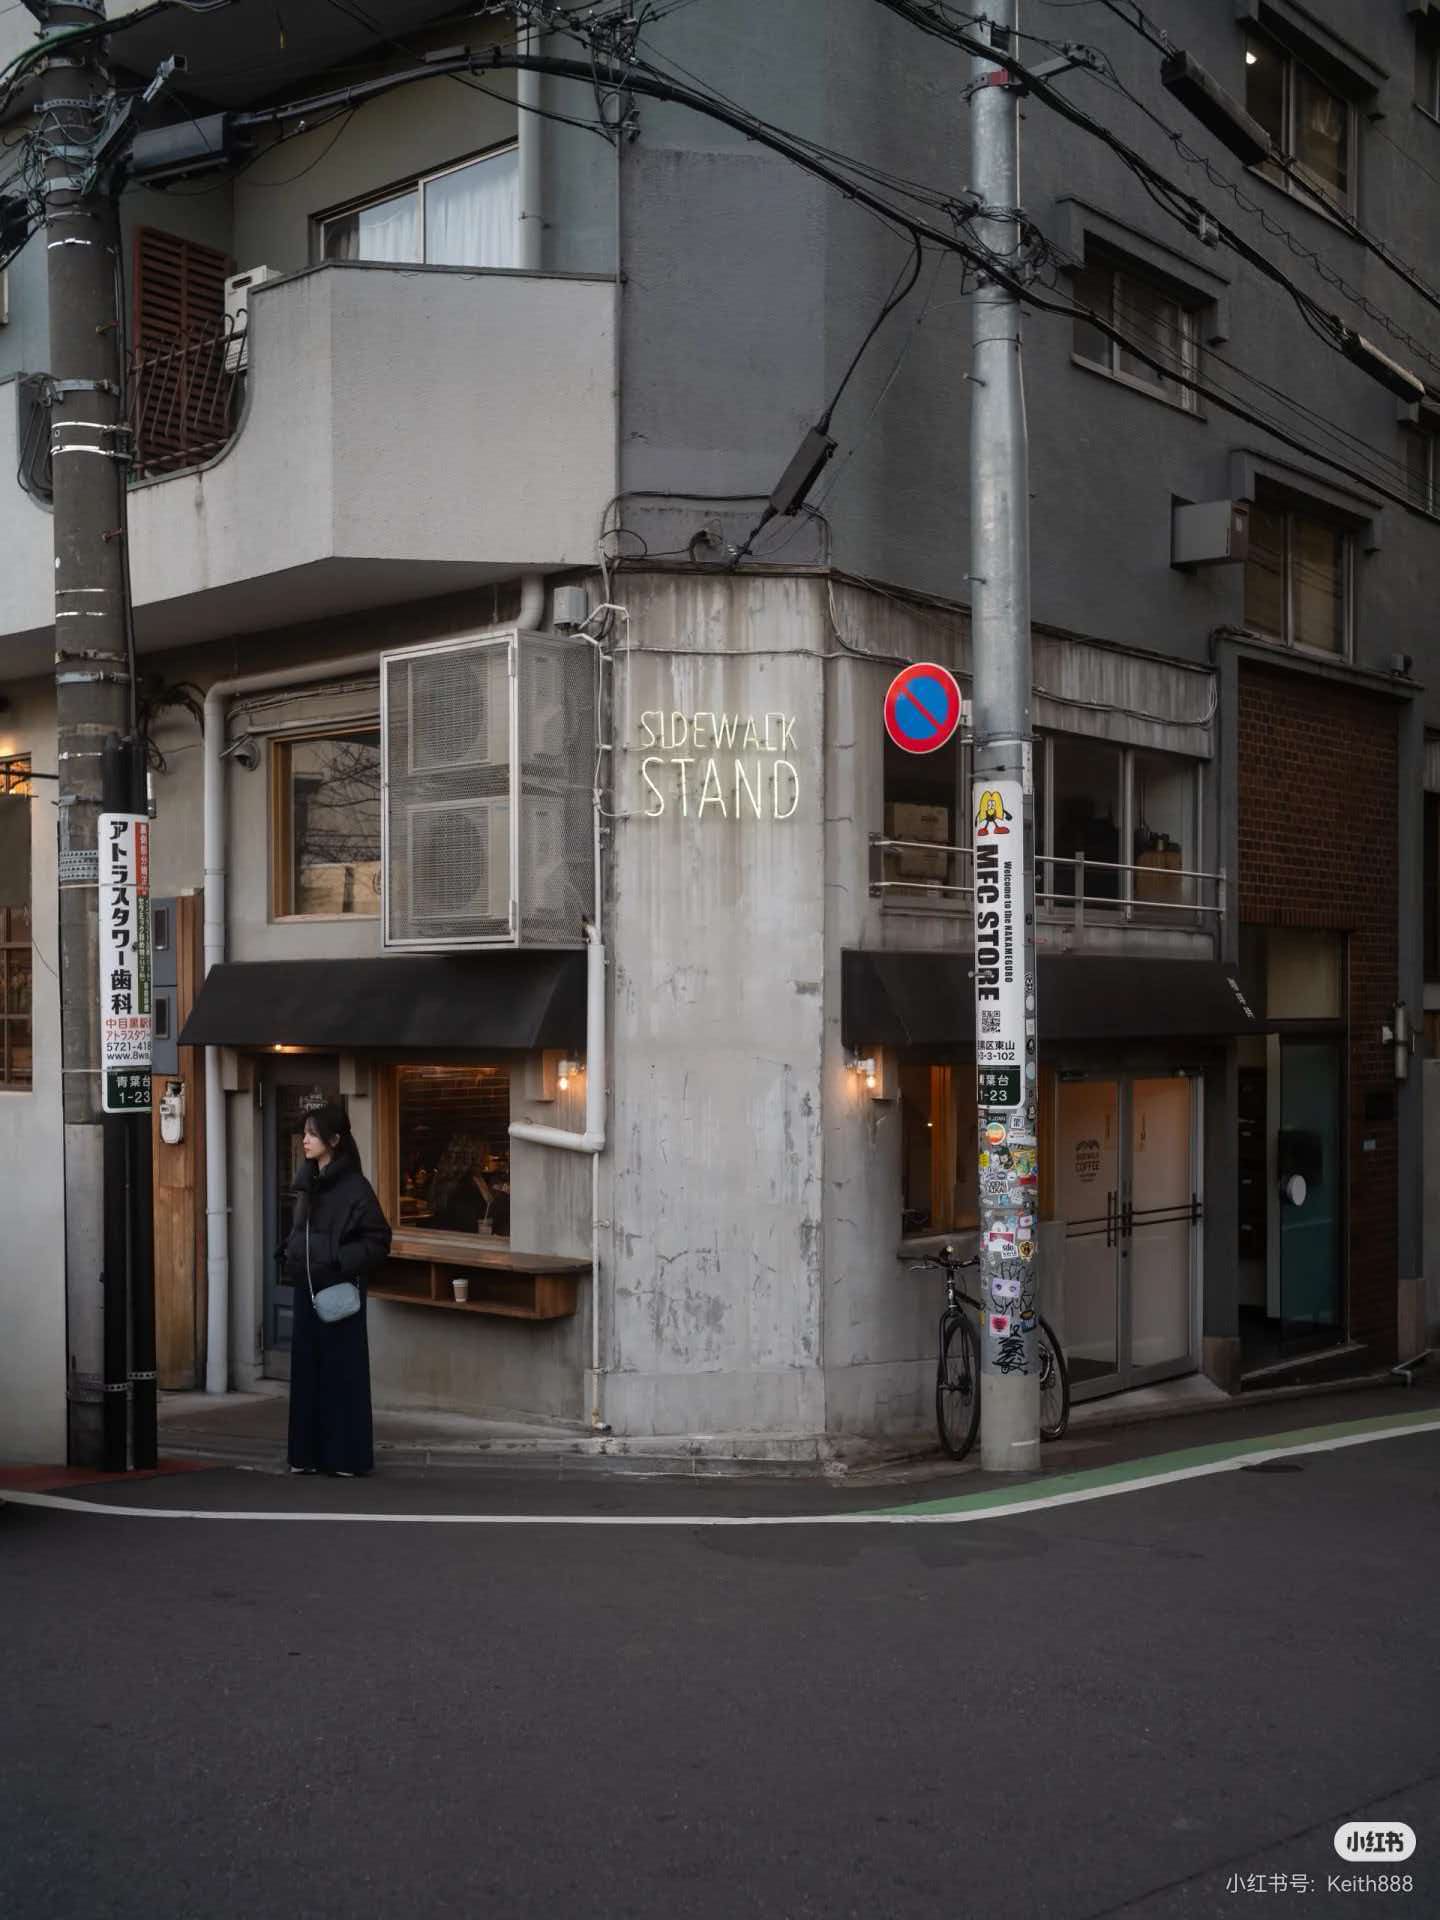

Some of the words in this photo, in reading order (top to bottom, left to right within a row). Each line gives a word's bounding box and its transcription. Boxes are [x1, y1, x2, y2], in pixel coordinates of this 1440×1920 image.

[640, 711, 798, 750] SIDEWALK
[642, 756, 799, 819] STAND
[976, 844, 999, 904] MFC
[1003, 861, 1013, 899] Welcome
[109, 820, 132, 1015] アトラスタワー歯科
[1003, 901, 1013, 909] to
[1004, 911, 1013, 924] the
[977, 911, 1000, 1001] STORE
[116, 1075, 151, 1088] 青葉台
[119, 1091, 151, 1105] 1-23
